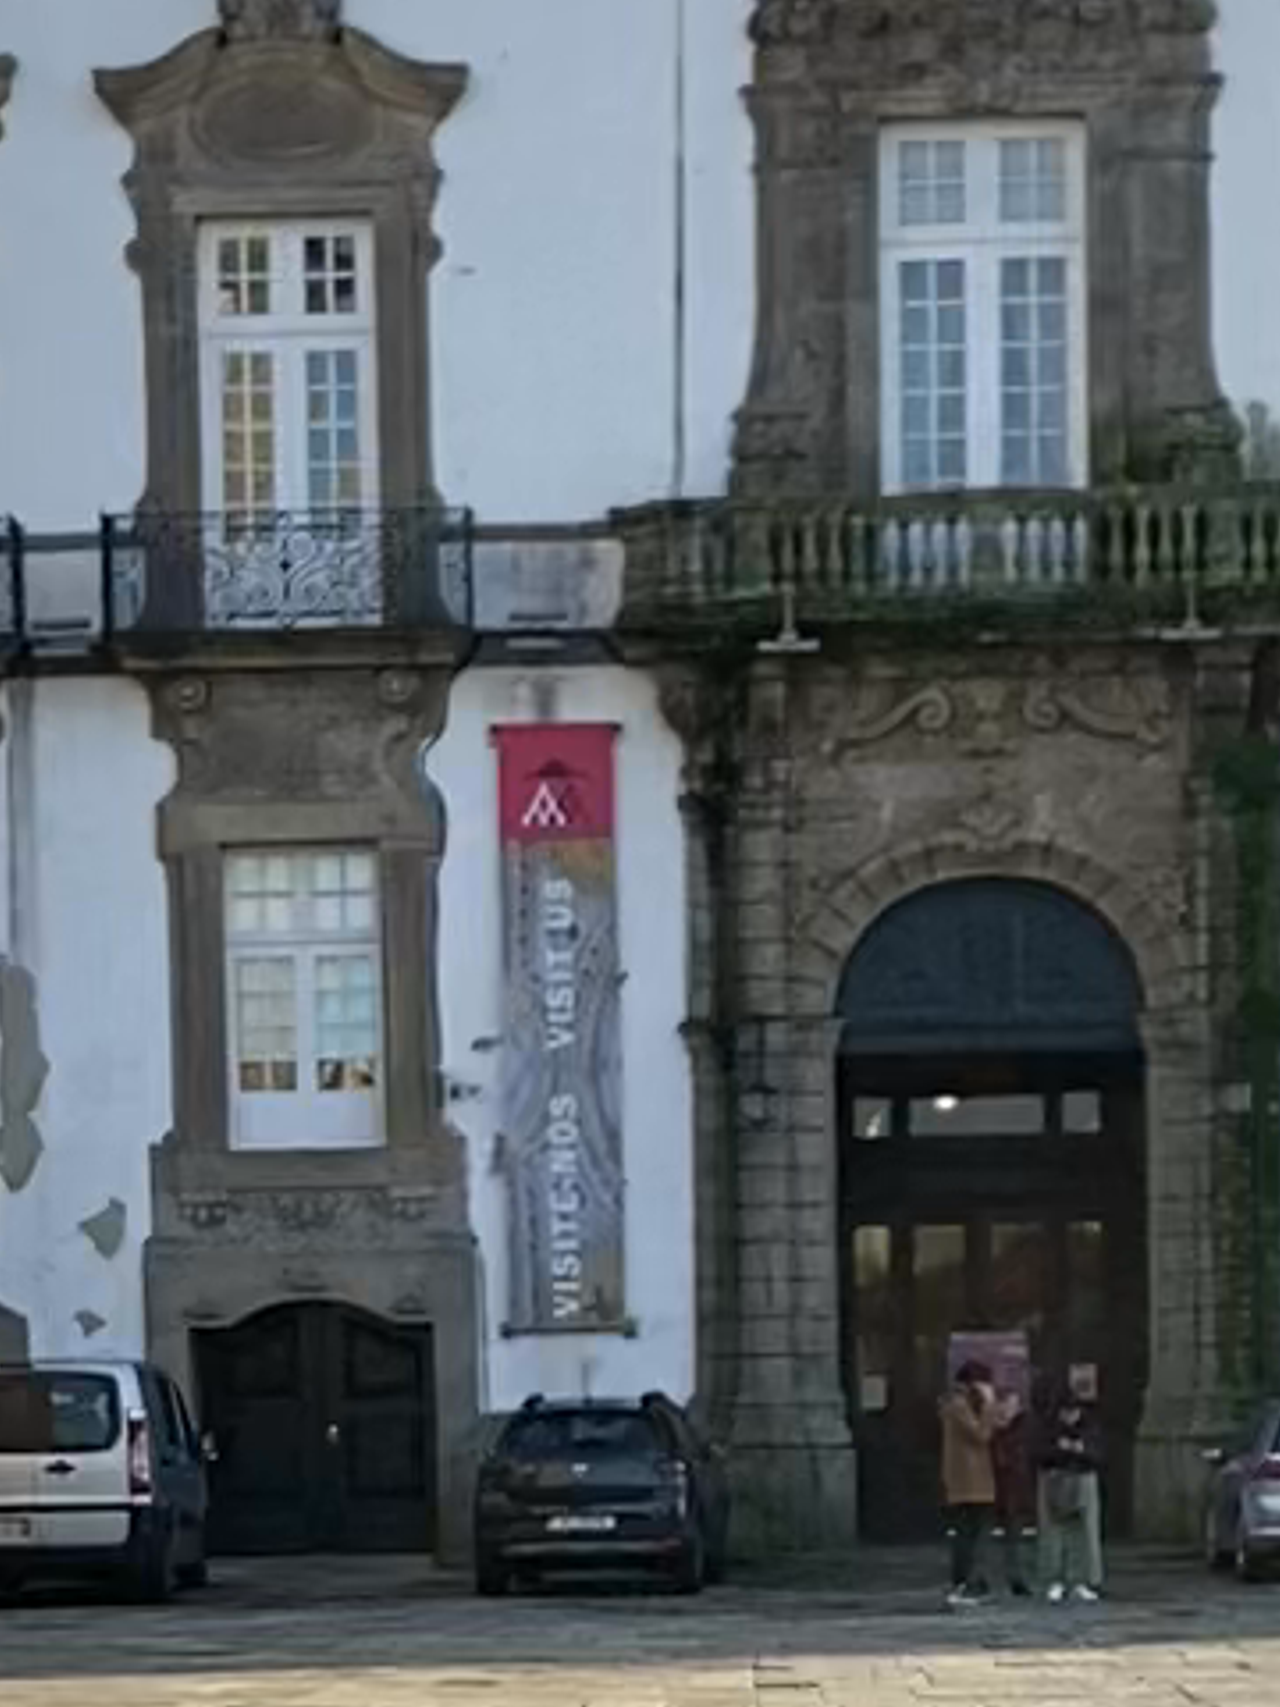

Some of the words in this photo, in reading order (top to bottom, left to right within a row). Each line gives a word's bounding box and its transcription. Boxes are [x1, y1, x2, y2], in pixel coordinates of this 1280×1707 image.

[542, 877, 574, 929] US
[542, 943, 576, 1050] VISIT
[549, 1093, 582, 1319] VISITE-NOS
